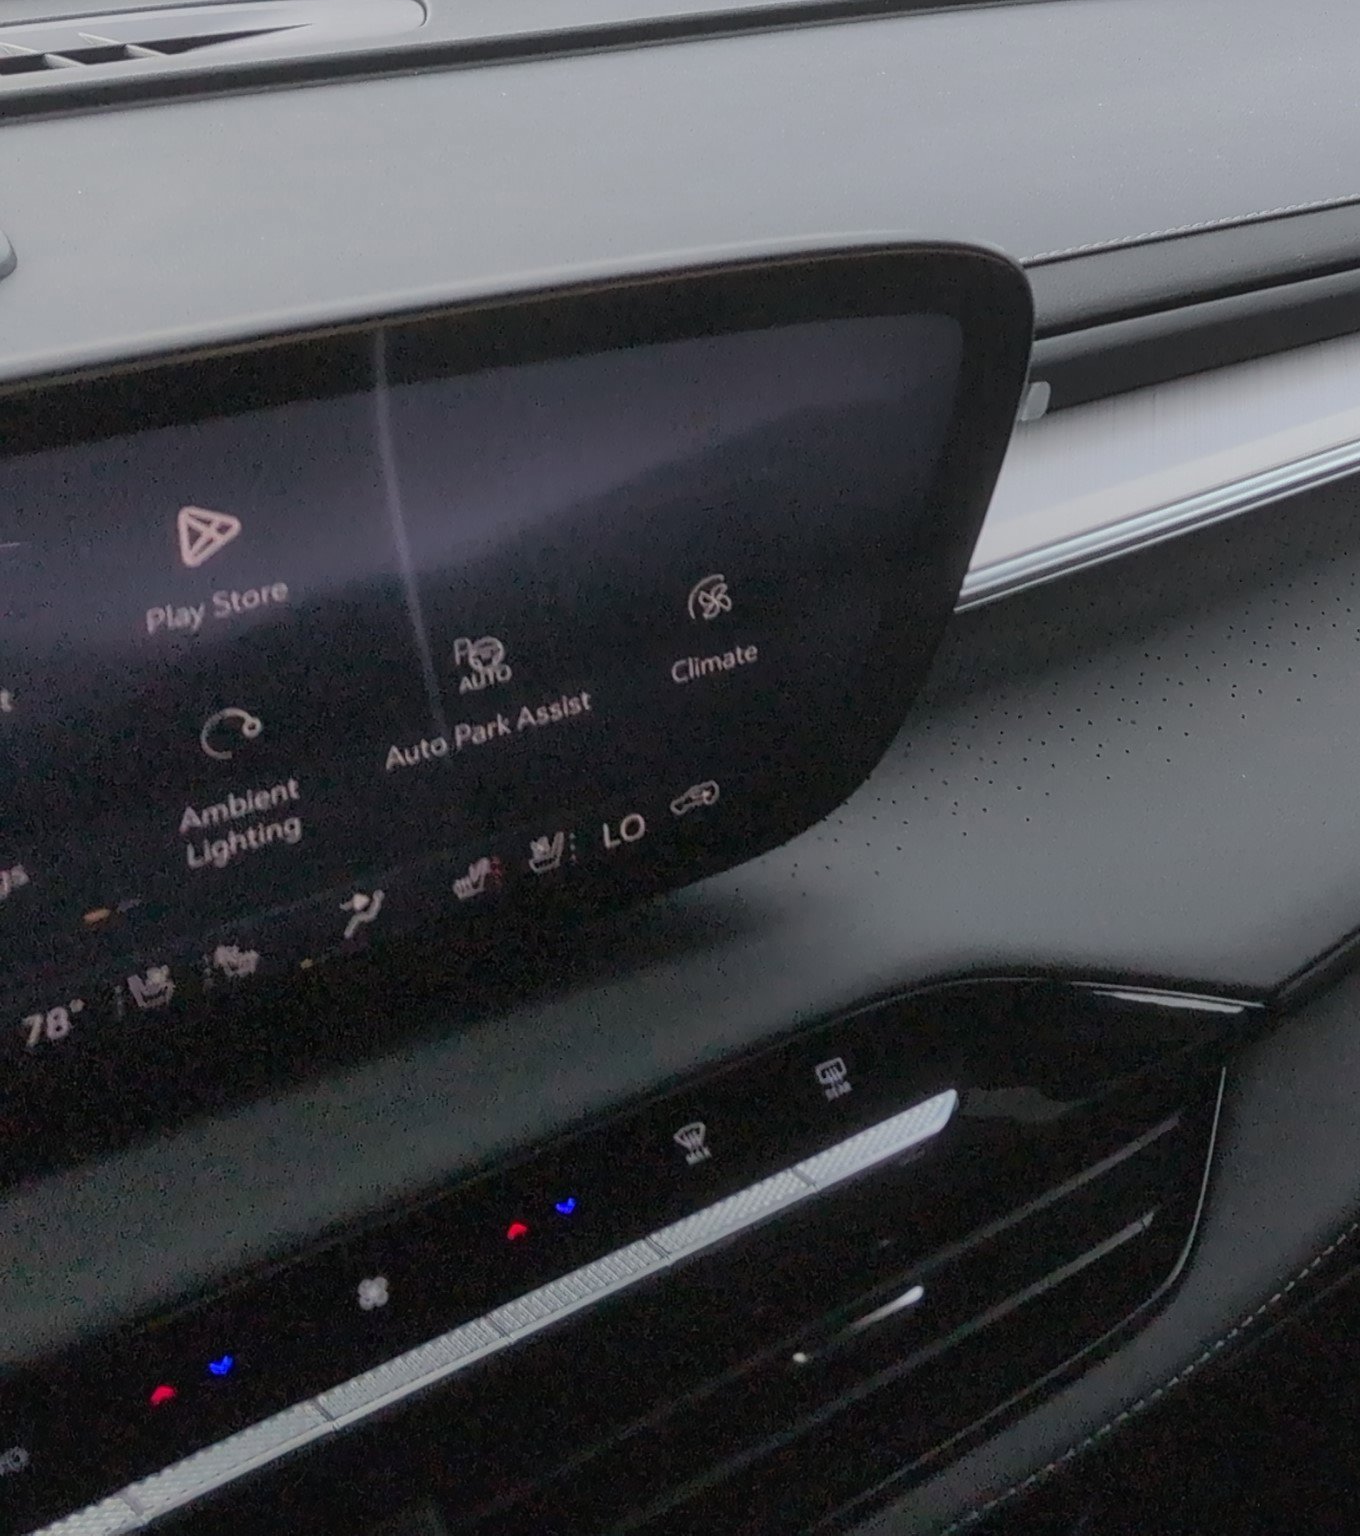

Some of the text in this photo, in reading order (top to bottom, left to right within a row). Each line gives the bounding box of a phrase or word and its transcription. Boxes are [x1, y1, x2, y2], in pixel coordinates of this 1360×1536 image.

[145, 580, 289, 634] Play Store
[459, 664, 513, 694] AUTO
[671, 644, 759, 684] Climate
[385, 691, 592, 770] Auto Park Assist
[178, 777, 299, 834] Ambient
[187, 815, 302, 870] Lighting
[602, 813, 645, 850] LO
[23, 999, 84, 1047] 78°
